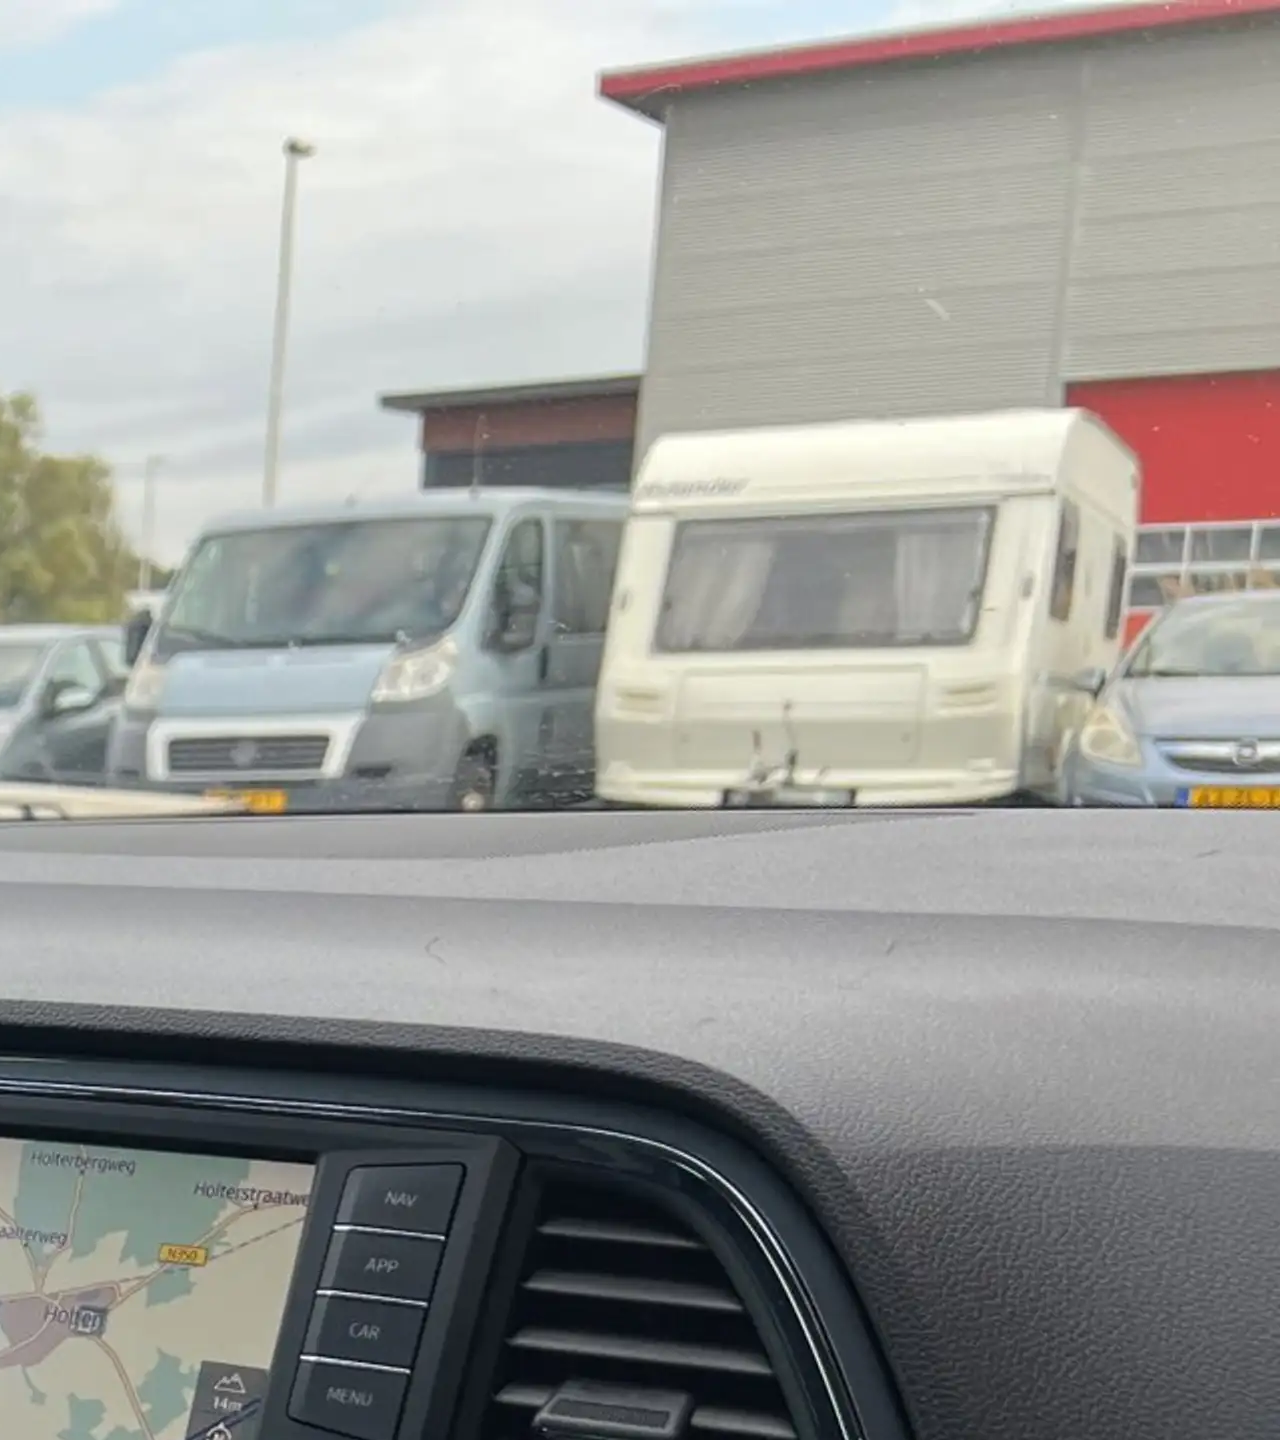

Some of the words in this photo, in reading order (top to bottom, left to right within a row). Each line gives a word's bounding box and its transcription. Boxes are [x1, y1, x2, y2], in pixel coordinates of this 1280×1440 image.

[385, 1191, 418, 1207] NAV
[365, 1257, 399, 1273] APP
[349, 1322, 380, 1340] CAR
[327, 1386, 373, 1407] MENU
